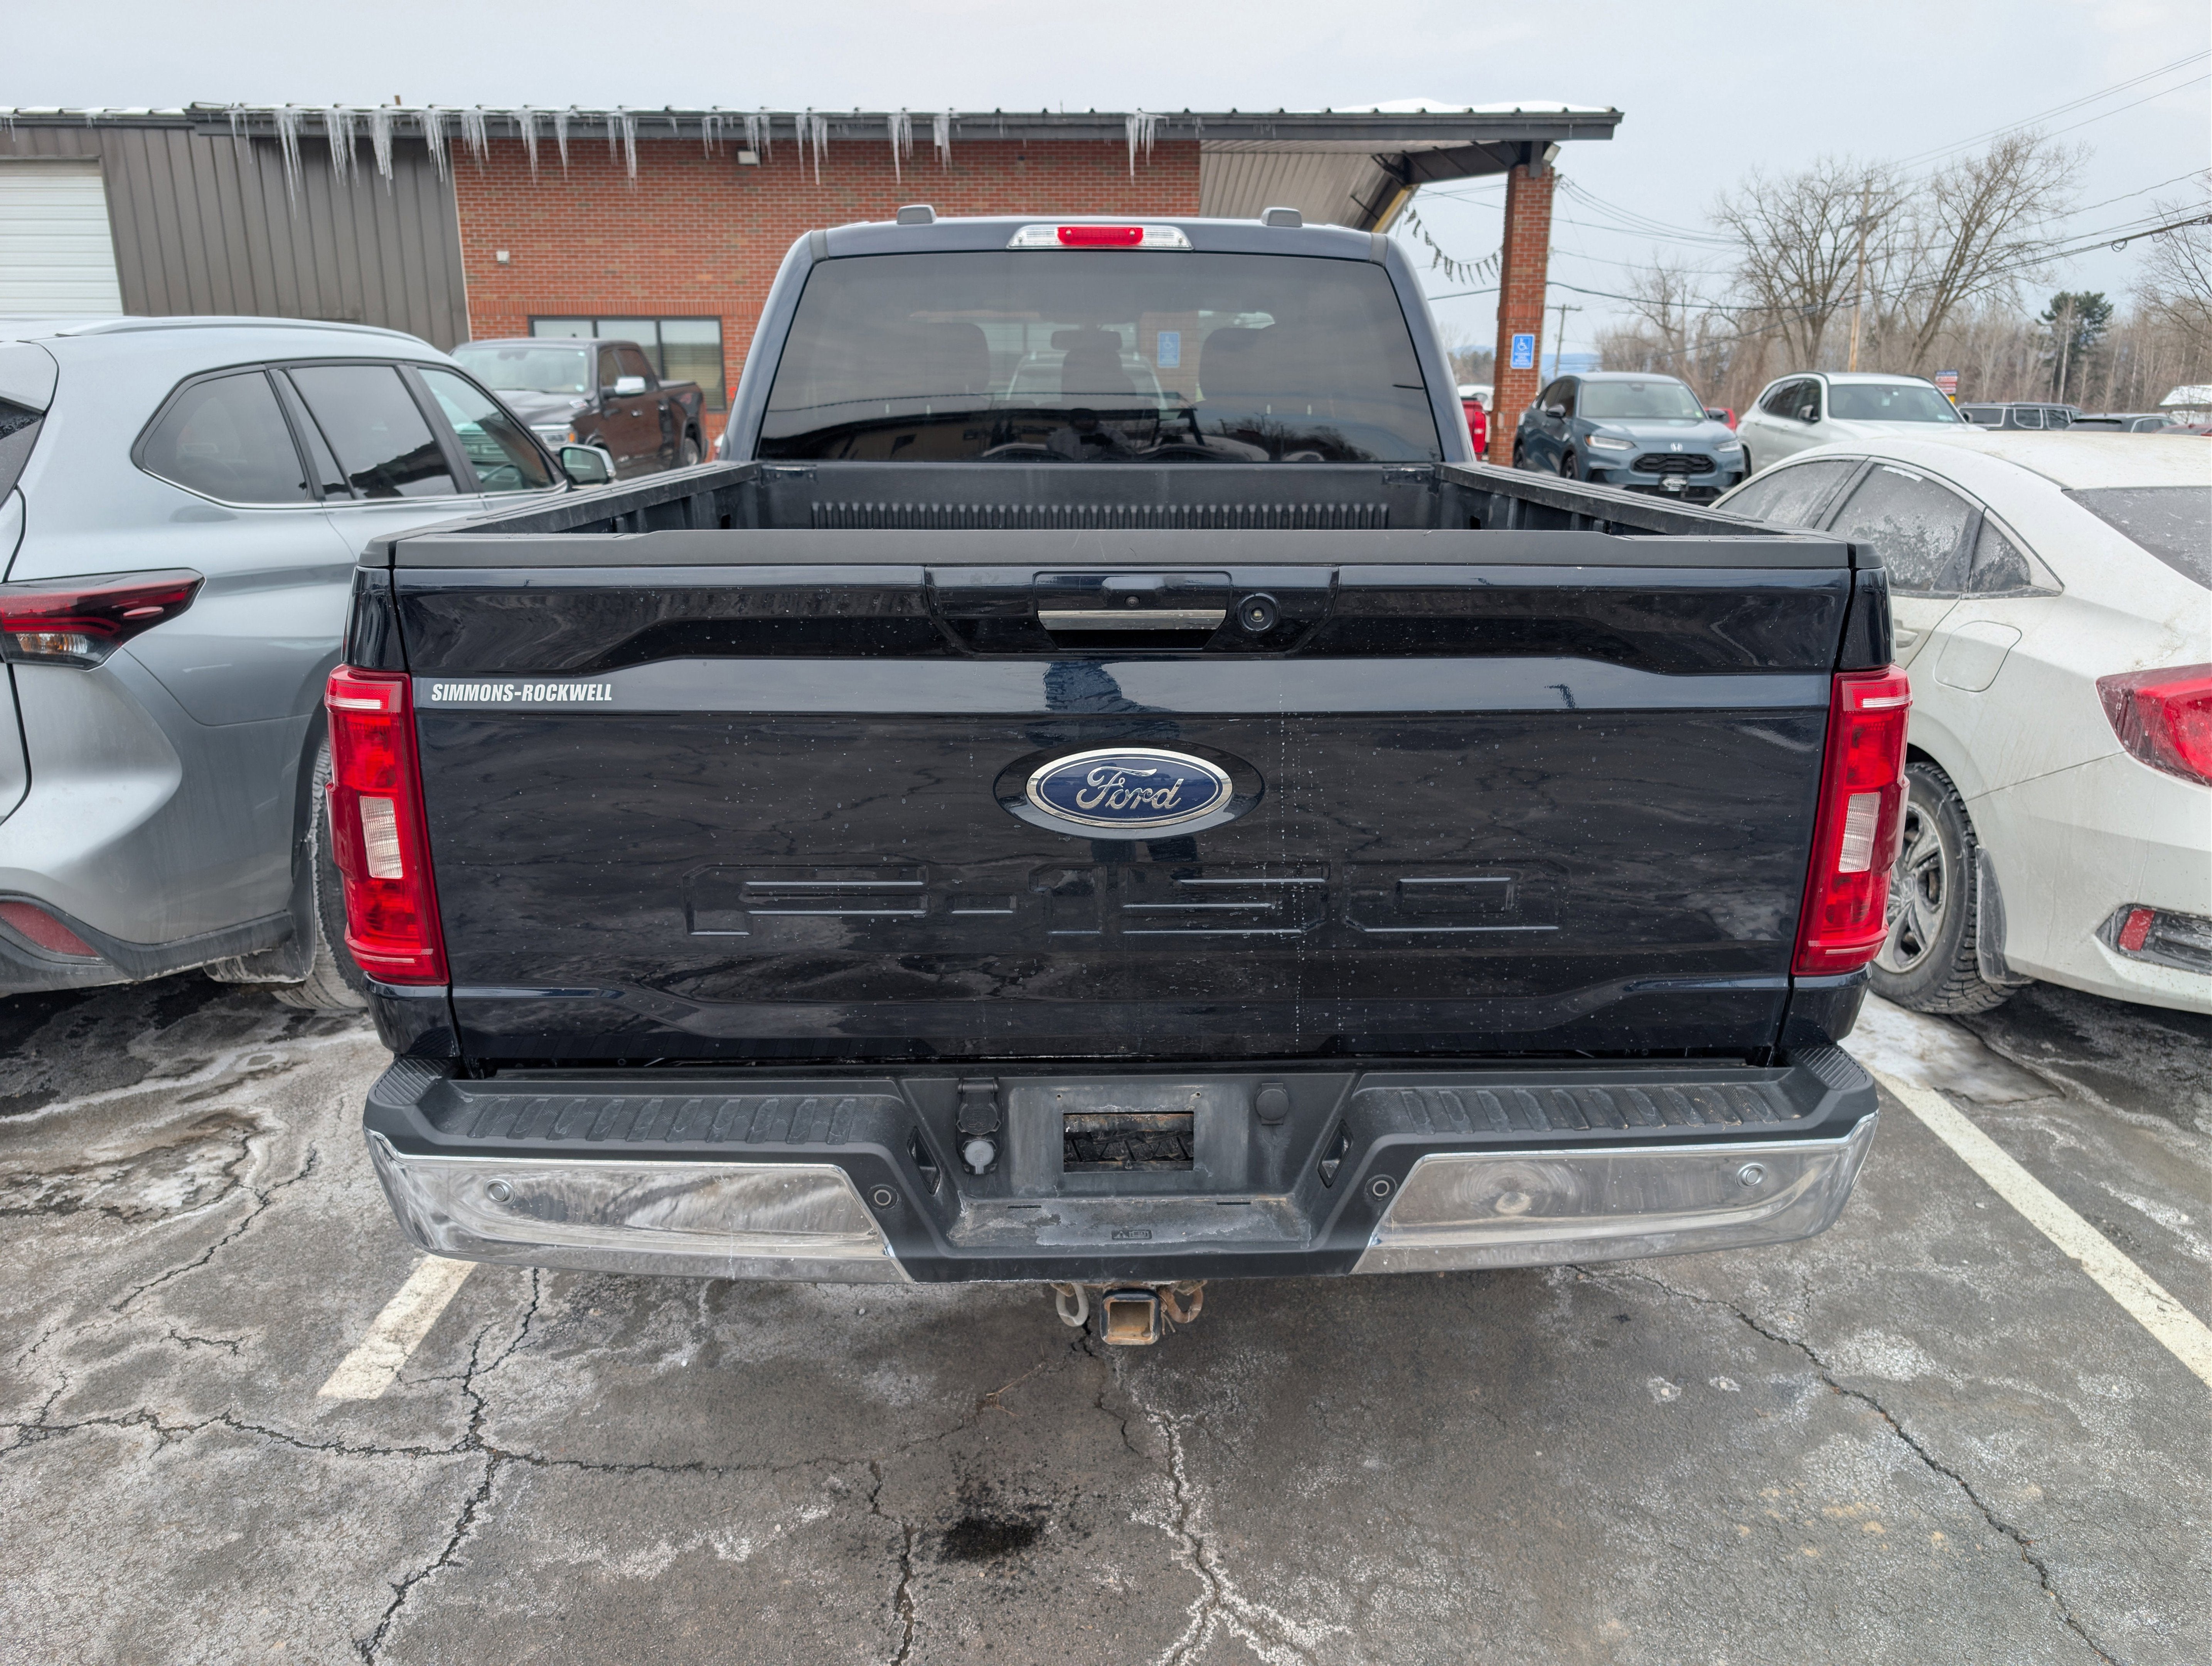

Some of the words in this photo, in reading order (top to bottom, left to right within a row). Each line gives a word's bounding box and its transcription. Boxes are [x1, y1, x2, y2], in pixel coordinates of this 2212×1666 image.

[431, 684, 612, 701] SIMMONS-ROCKWELL
[1076, 766, 1184, 809] Ford
[682, 860, 1571, 935] F-150
